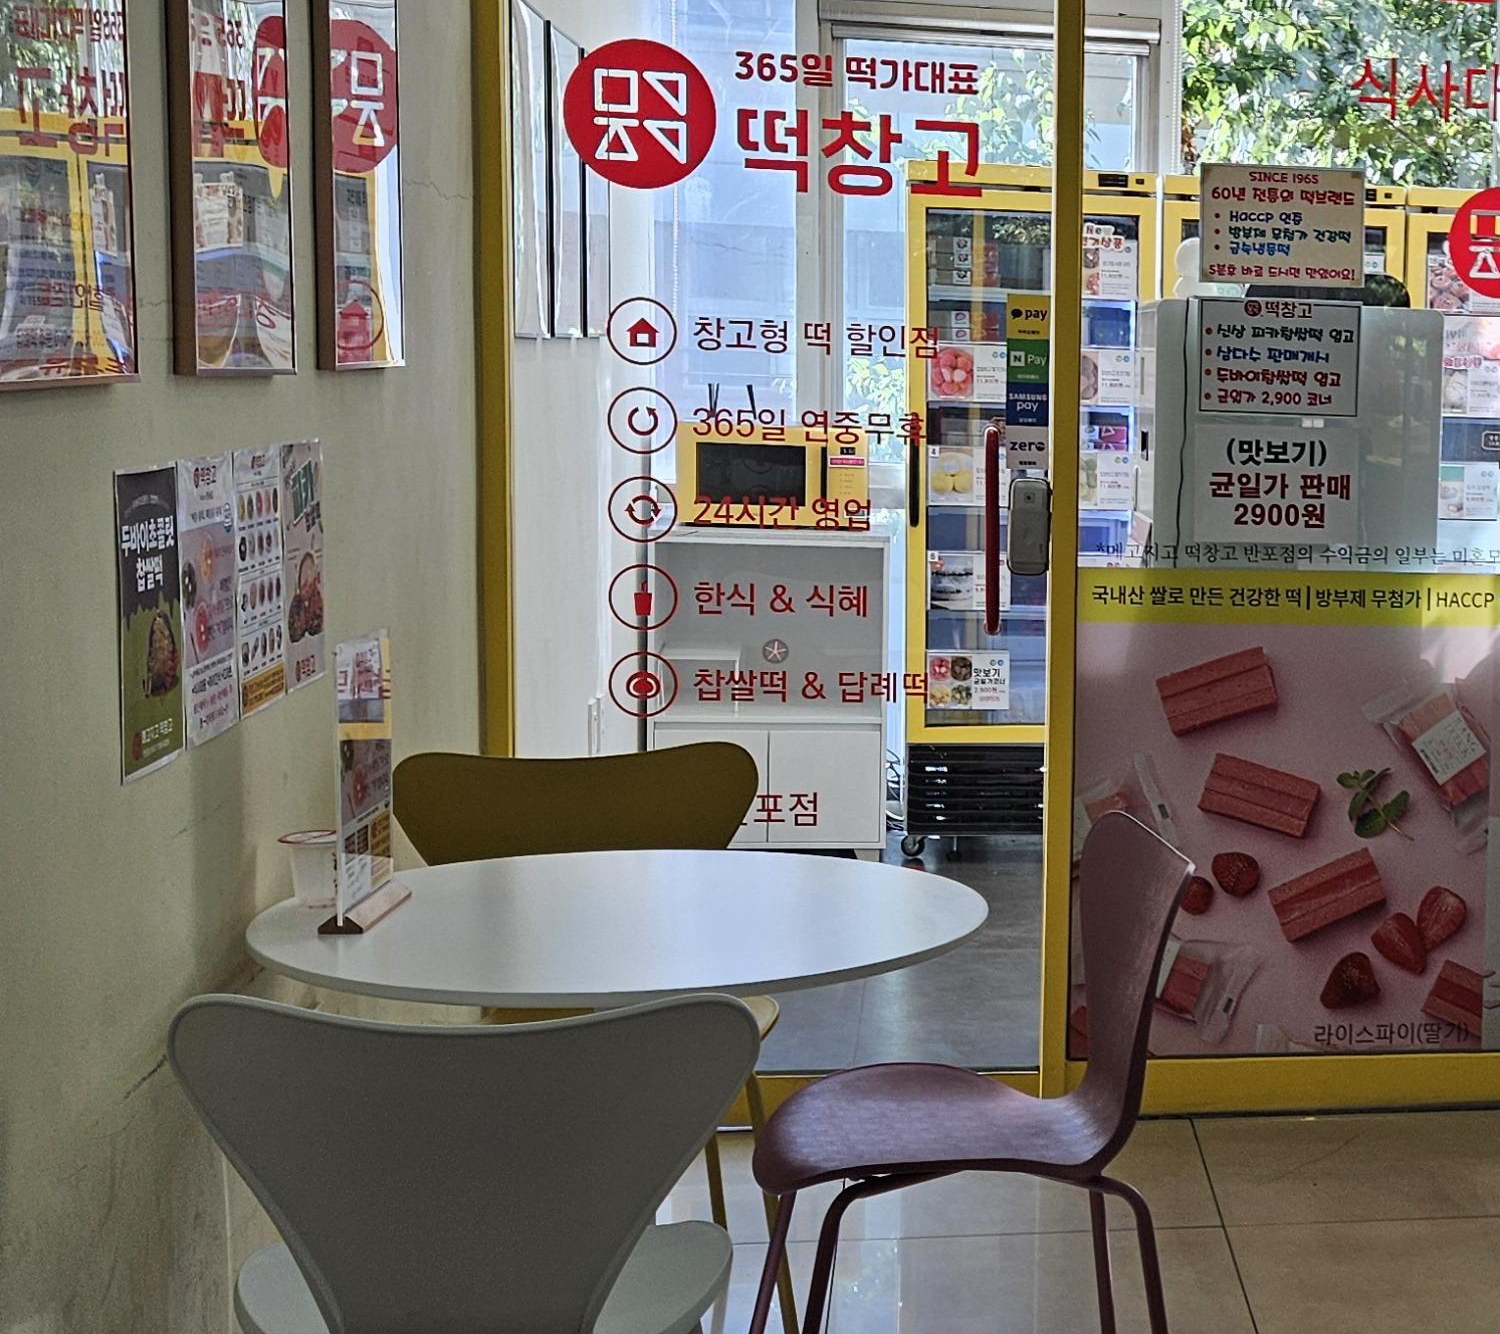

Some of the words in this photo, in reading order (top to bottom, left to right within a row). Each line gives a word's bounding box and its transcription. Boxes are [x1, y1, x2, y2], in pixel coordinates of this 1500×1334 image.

[734, 50, 834, 89] 365일
[845, 55, 980, 97] 떡가대표
[734, 105, 984, 200] 떡창고
[1249, 171, 1289, 184] SINCE
[1292, 172, 1320, 185] 1965
[1211, 186, 1247, 202] 60년
[1252, 188, 1294, 204] 전통의
[1300, 189, 1356, 206] 떡브랜드
[1024, 308, 1048, 322] pay
[1264, 300, 1313, 320] 떡창고
[691, 315, 791, 356] 창고형
[802, 320, 833, 357] 떡
[844, 320, 941, 361] 할인점
[1027, 353, 1048, 367] Pay
[1008, 392, 1047, 402] SAMSUNG
[1016, 400, 1040, 413] pay
[1261, 390, 1302, 406] 2,900
[1306, 392, 1333, 407] 코너
[691, 406, 788, 442] 365일
[800, 408, 928, 447] 연중무휴
[1226, 437, 1328, 468] (맛보기)
[1208, 471, 1290, 500] 균일가
[1299, 472, 1352, 501] 판매
[692, 493, 801, 530] 24시간
[809, 495, 872, 534] 영업
[1233, 502, 1327, 530] 2900원
[120, 515, 175, 559] 두바이초콜릿
[1184, 543, 1238, 564] 떡창고
[1242, 544, 1314, 565] 반포점의
[1319, 544, 1388, 566] 수익금의
[1393, 545, 1447, 566] 일부는
[693, 580, 757, 618] 한식
[768, 583, 798, 615] &
[804, 582, 871, 620] 식혜
[1091, 585, 1145, 607] 국내산
[1149, 585, 1185, 608] 쌀로
[1189, 586, 1224, 608] 만든
[1229, 587, 1281, 610] 건강한
[1285, 587, 1302, 610] 떡
[1315, 588, 1366, 610] 방부제
[1370, 588, 1422, 611] 무첨가
[1435, 590, 1495, 609] HACCP
[692, 667, 790, 704] 찹쌀떡
[800, 671, 827, 702] &
[836, 669, 930, 705] 답례떡
[739, 790, 820, 829] 포점
[1312, 1020, 1470, 1047] 라이스파이(딸기)
